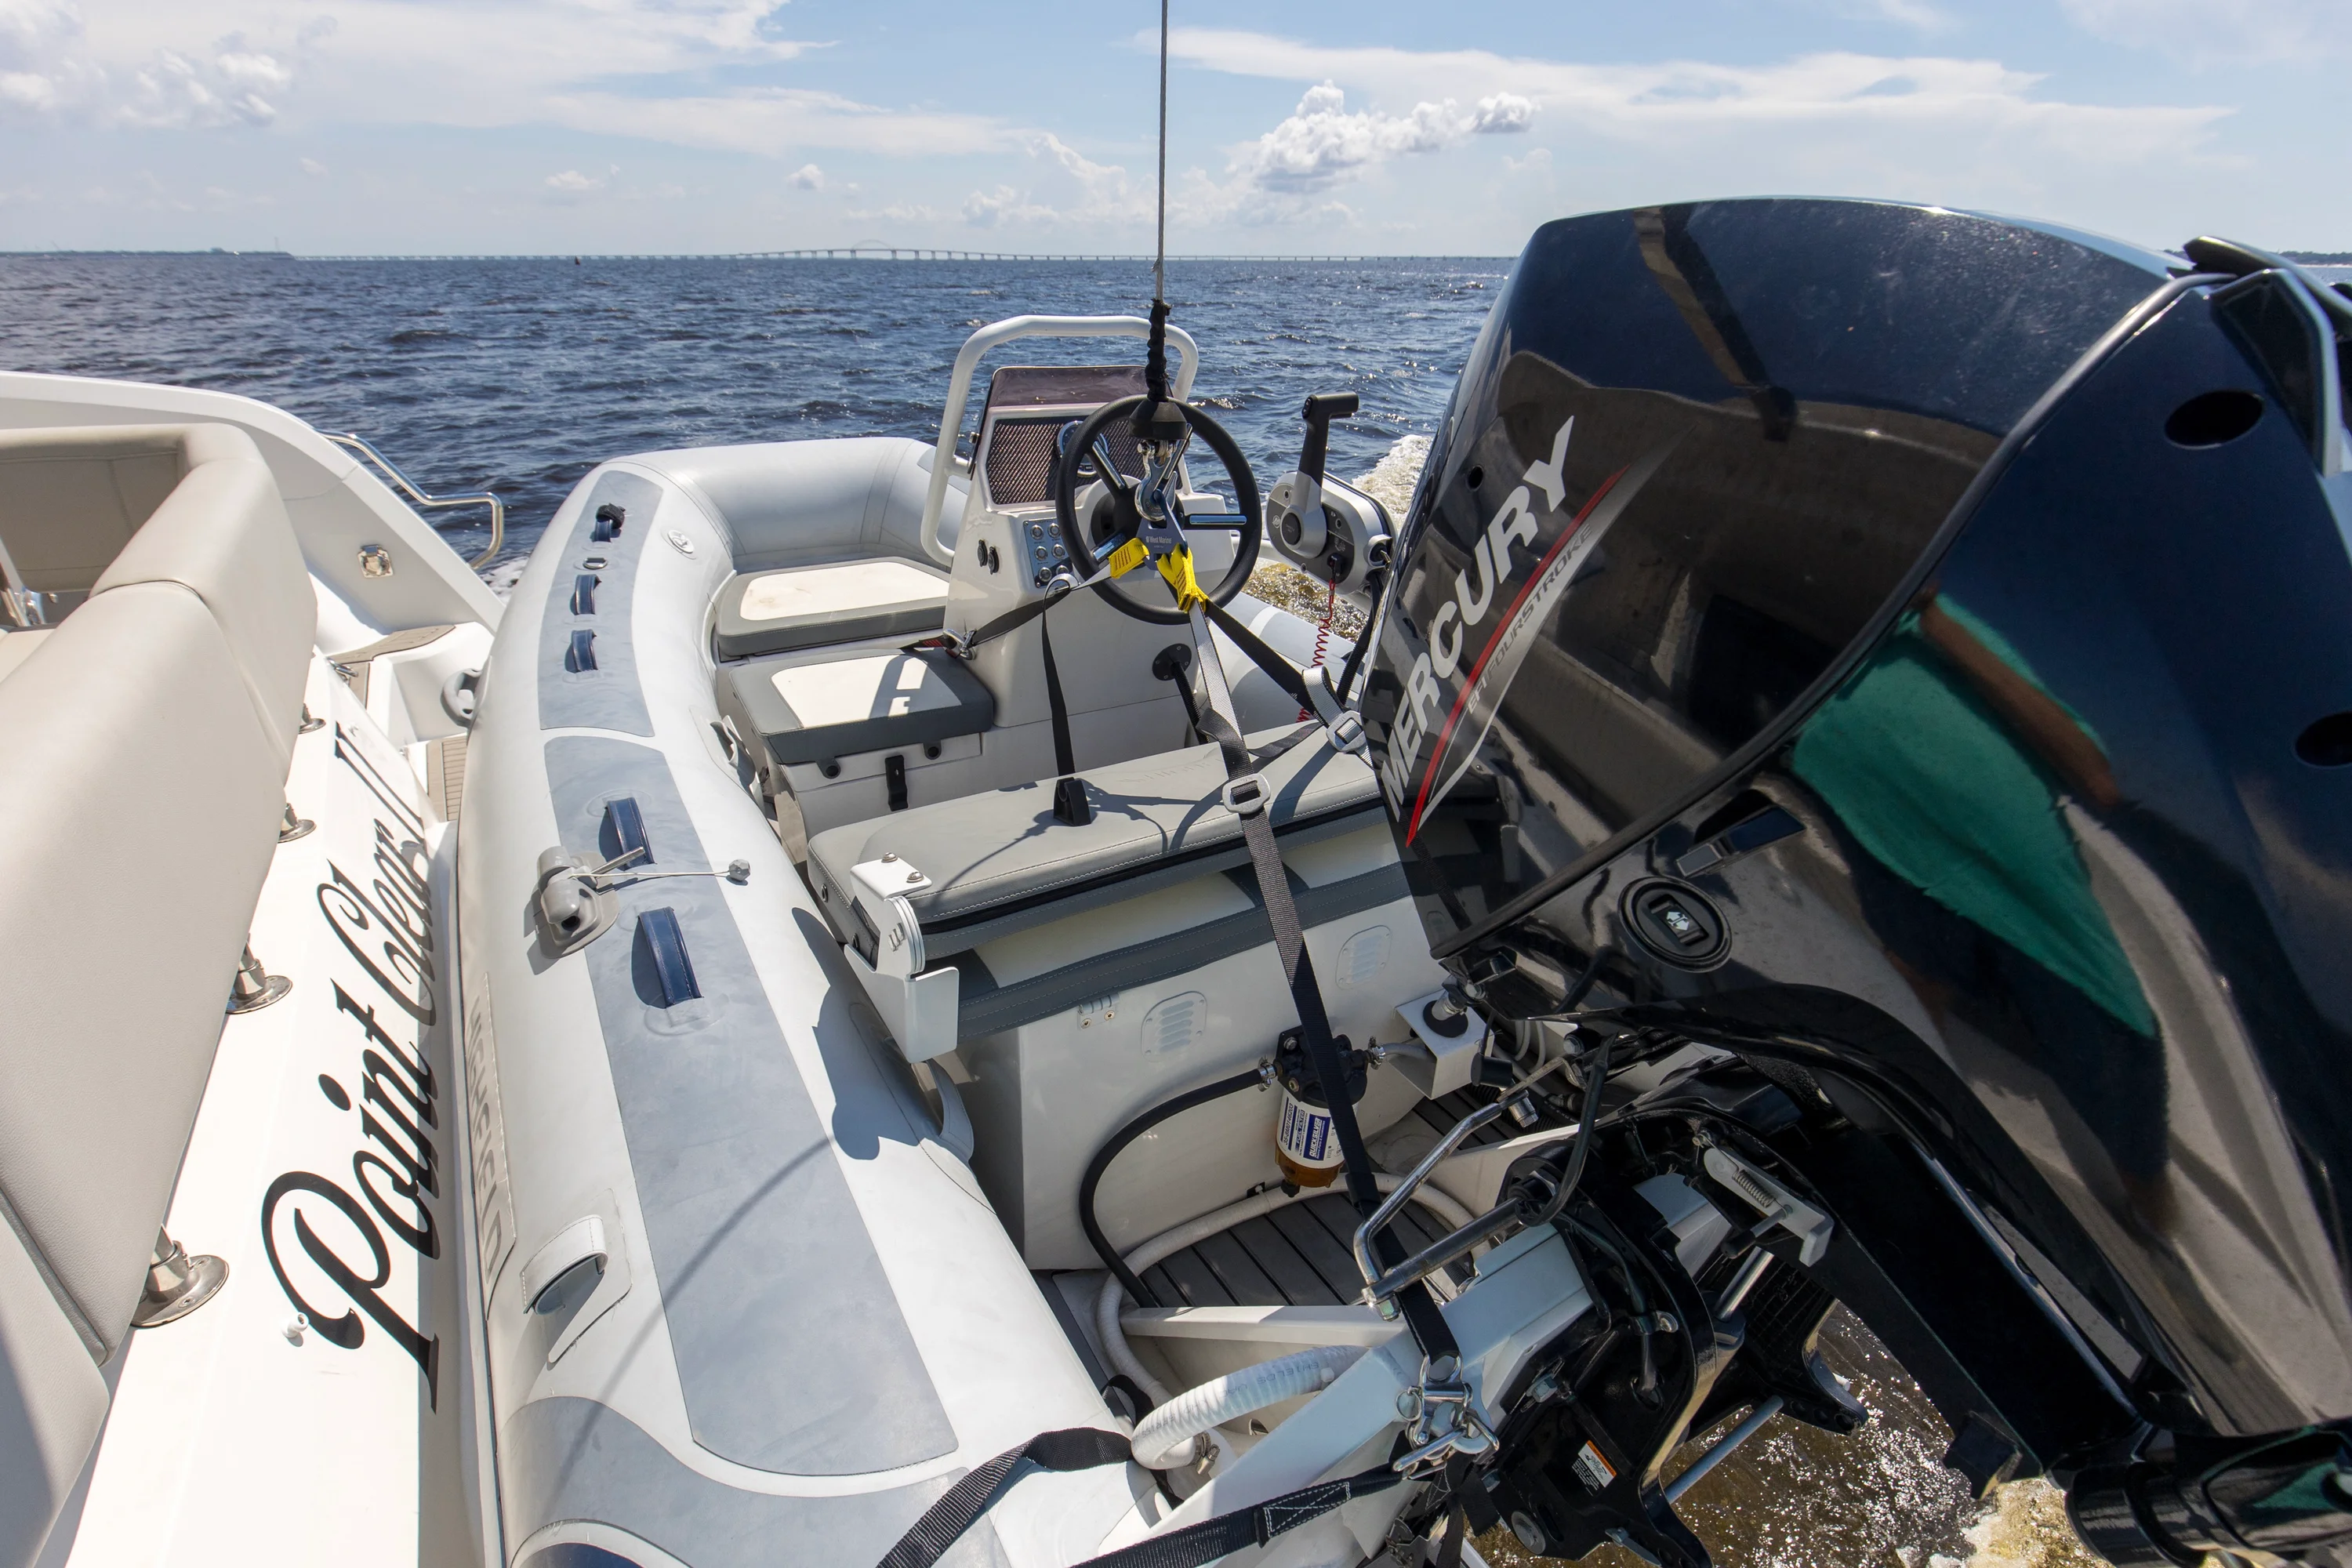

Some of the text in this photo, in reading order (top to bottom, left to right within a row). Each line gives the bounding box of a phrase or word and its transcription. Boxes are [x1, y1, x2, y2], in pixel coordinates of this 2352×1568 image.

[1381, 416, 1574, 822] MERCURY
[1489, 523, 1592, 681] FOURSTROKE
[316, 818, 437, 1027] Clear
[261, 977, 441, 1414] Point
[466, 995, 503, 1284] HIGHFIELD
[1308, 1116, 1322, 1157] QUICKSILVER
[1257, 1362, 1319, 1385] SHIELDS
